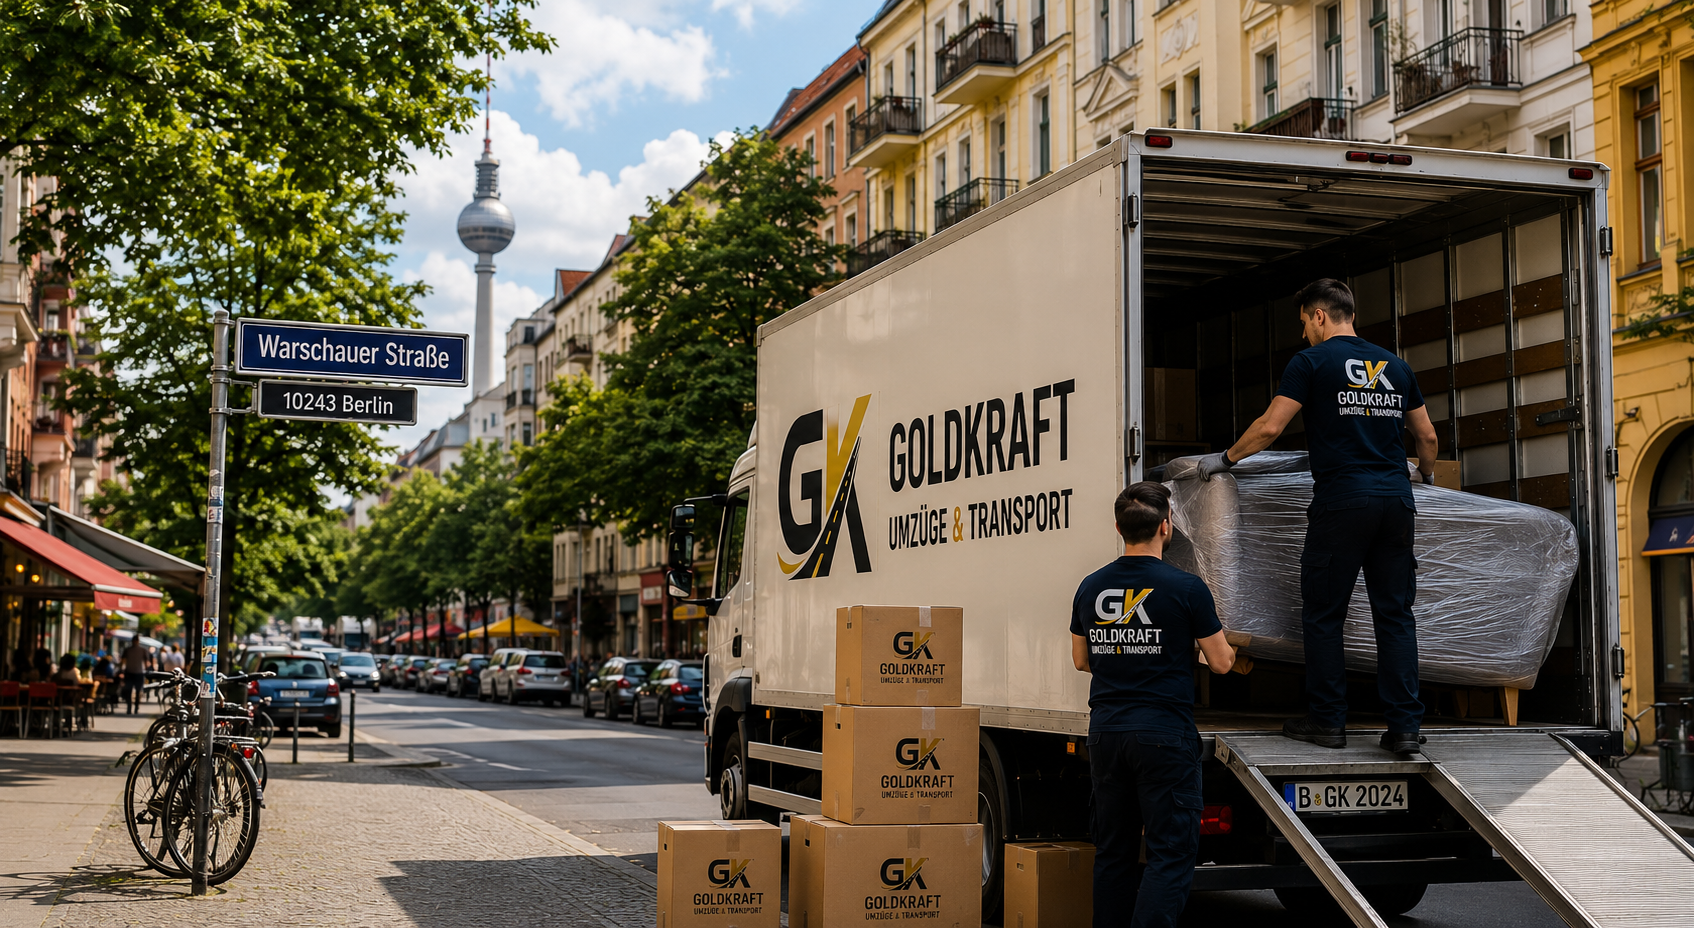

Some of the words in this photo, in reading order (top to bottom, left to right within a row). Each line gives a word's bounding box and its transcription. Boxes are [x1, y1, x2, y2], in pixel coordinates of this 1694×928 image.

[258, 333, 379, 365] Warschauer
[385, 341, 449, 369] Straße
[1345, 359, 1395, 390] GK
[283, 391, 336, 412] 10243
[342, 394, 393, 415] Berlin
[1337, 391, 1403, 408] GOLDKRAFT
[889, 378, 1075, 493] GOLDKRAFT
[778, 394, 872, 580] GK
[889, 504, 947, 550] UMZÜGE
[952, 506, 964, 542] &
[968, 488, 1073, 540] TRANSPORT
[1095, 588, 1154, 625] GK
[893, 631, 935, 660] GK
[1089, 628, 1162, 643] GOLDKRAFT
[880, 663, 945, 675] GOLDKRAFT
[895, 738, 941, 771] GK
[881, 775, 954, 788] GOLDKRAFT
[1299, 786, 1311, 808] B
[1325, 785, 1350, 807] GK
[1356, 784, 1404, 807] 2024
[708, 859, 751, 889] GK
[880, 858, 928, 891] GK
[693, 893, 763, 905] GOLDKRAFT
[864, 895, 941, 909] GOLDKRAFT
